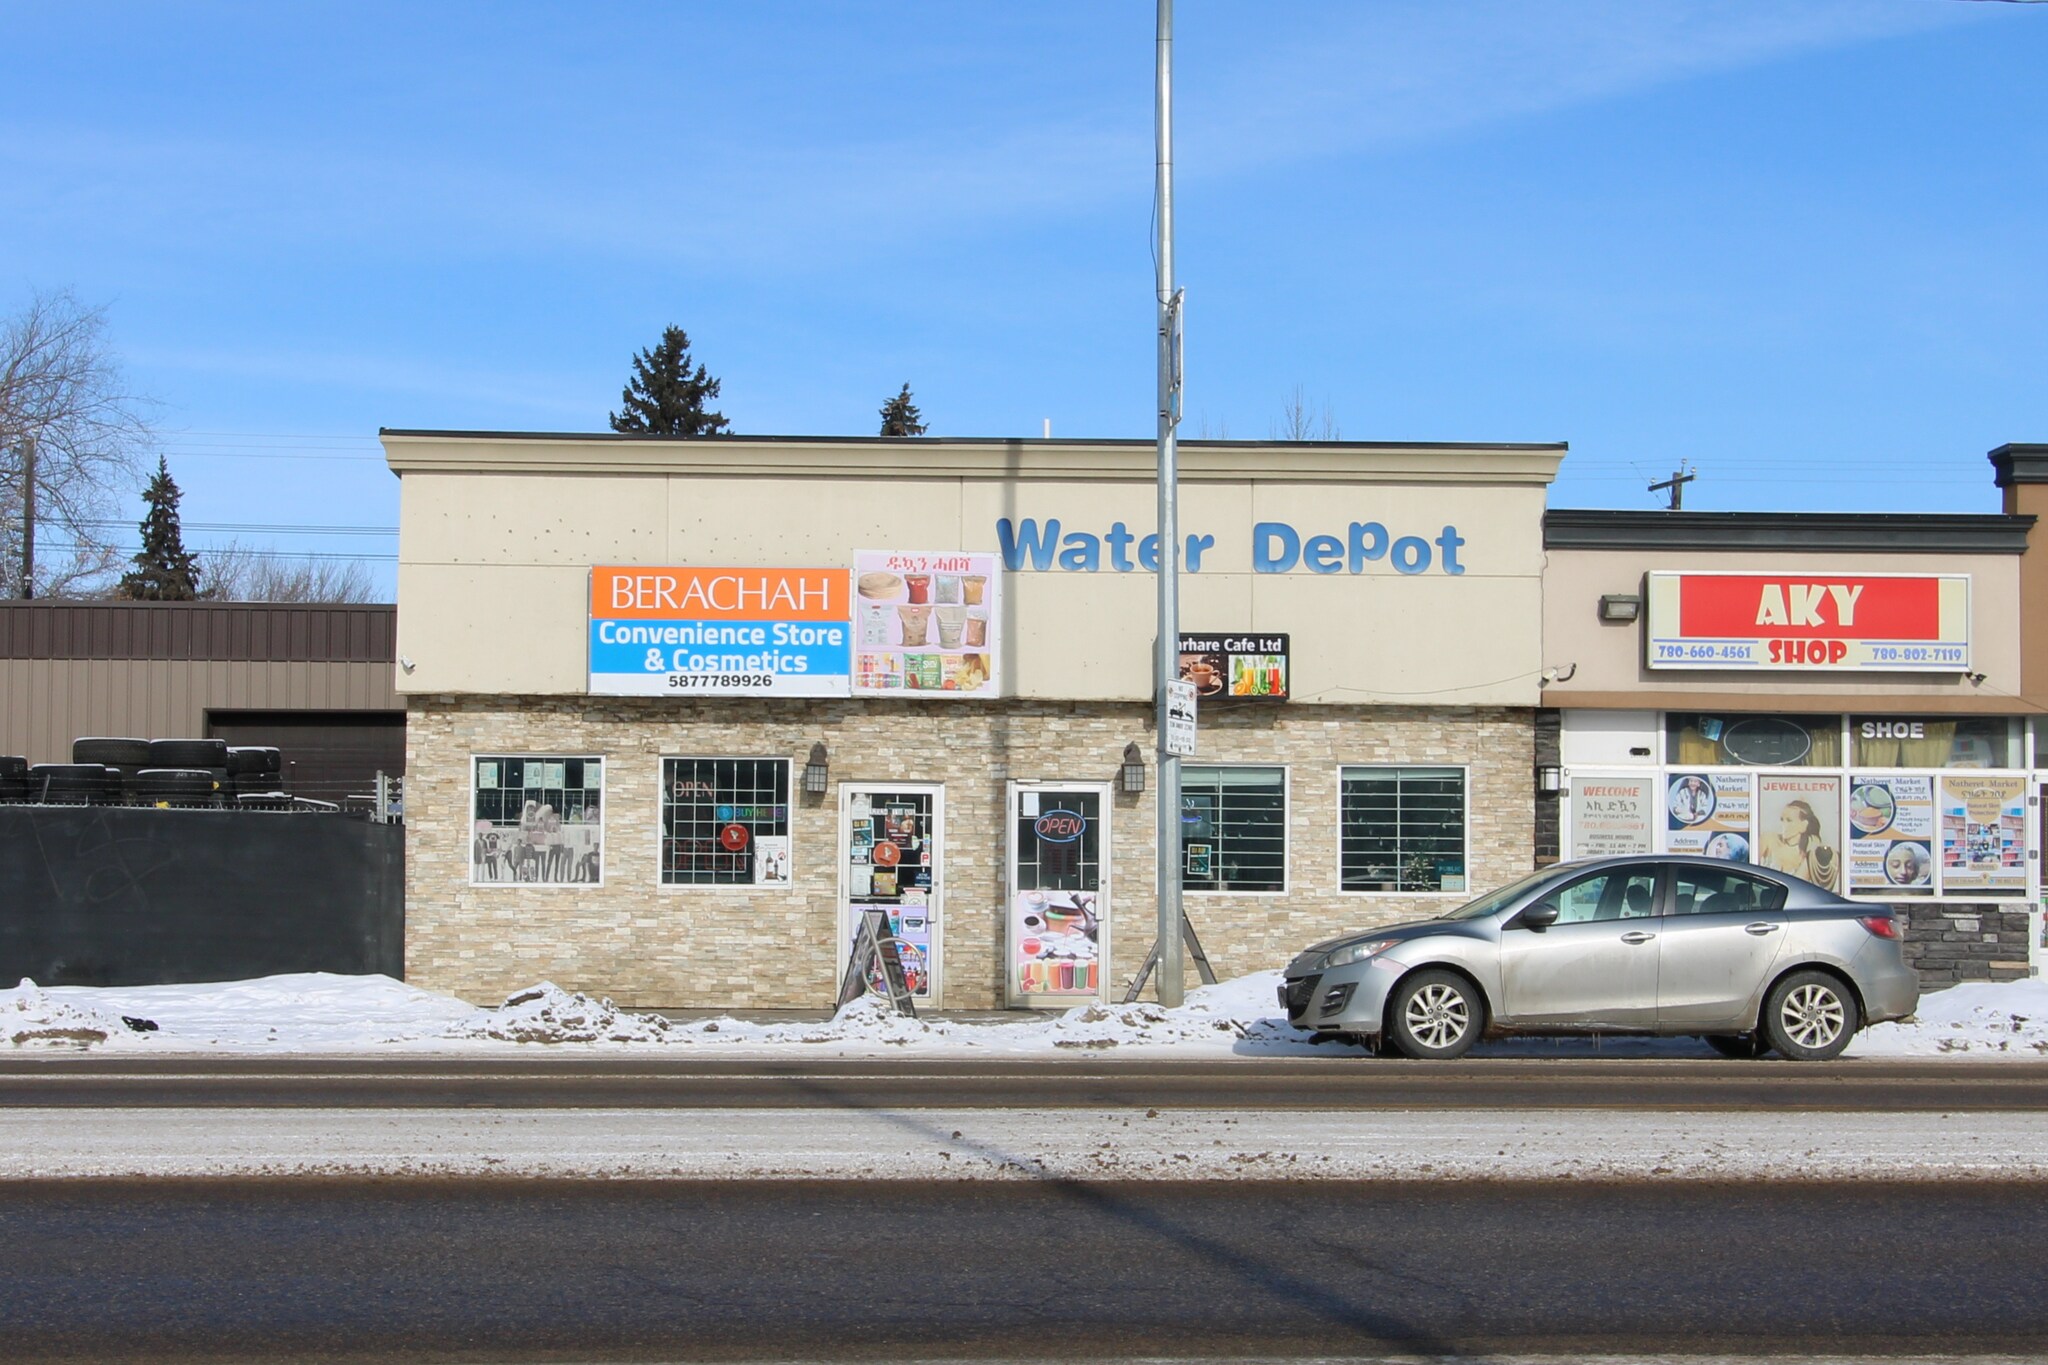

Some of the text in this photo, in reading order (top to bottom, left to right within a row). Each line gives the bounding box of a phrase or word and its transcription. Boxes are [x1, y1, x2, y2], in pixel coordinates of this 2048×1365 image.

[1252, 521, 1465, 575] DePot
[612, 575, 829, 611] BERACHAH
[1756, 583, 1863, 627] AKY
[599, 621, 842, 646] Convenience Store
[1179, 637, 1281, 652] rhare Cafe Ltd
[1658, 645, 1751, 660] 780-660-4561
[1768, 639, 1848, 665] SHOP
[645, 647, 808, 672] & Cosmetics
[1872, 647, 1962, 662] 780-802-7119
[668, 674, 773, 688] 5877789926
[1861, 722, 1924, 739] SHOE
[672, 781, 713, 797] OPEN
[1583, 786, 1640, 797] WELCOME
[1763, 782, 1835, 791] JEWELLERY
[736, 808, 782, 817] BUY HEE
[1037, 818, 1081, 834] OPEN
